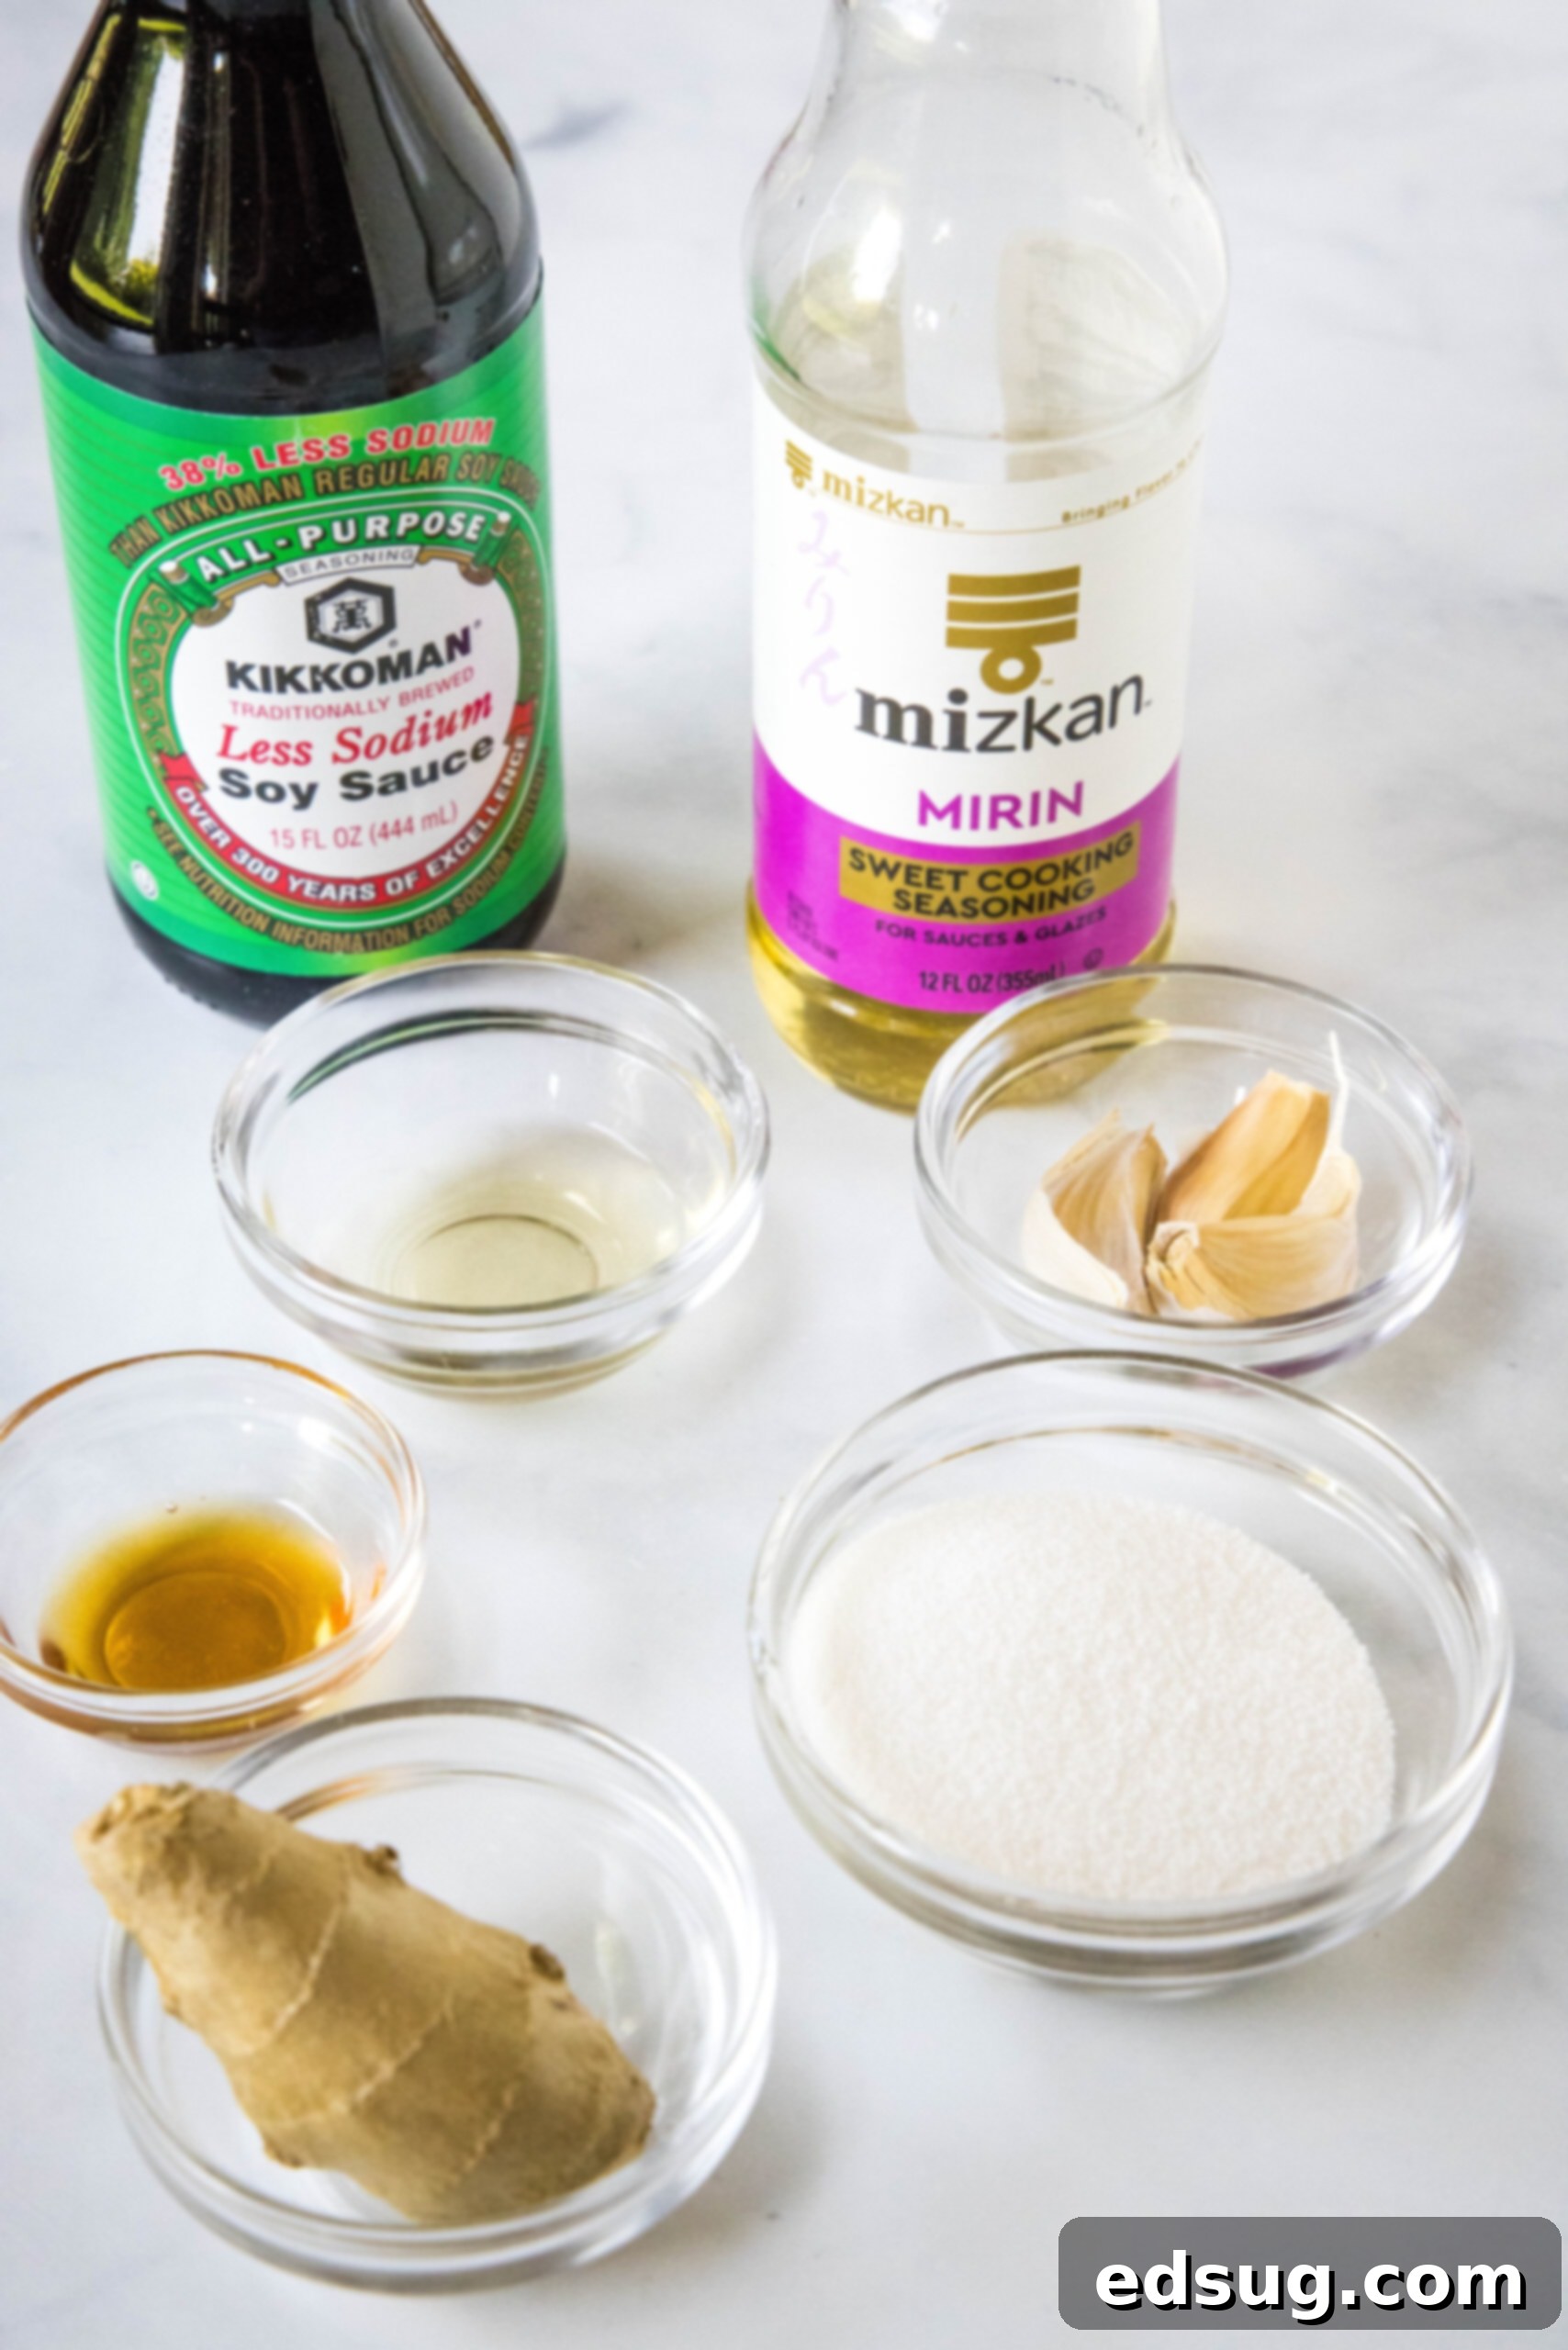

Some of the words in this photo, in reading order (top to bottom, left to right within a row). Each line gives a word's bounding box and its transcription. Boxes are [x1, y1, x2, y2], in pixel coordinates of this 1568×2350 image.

[159, 452, 241, 491] 38%
[252, 431, 351, 472] LESS
[365, 418, 496, 456] SODIUM
[108, 515, 162, 569] THAN
[152, 472, 304, 535] KIKKOMAN
[314, 453, 450, 497] REGULAR
[457, 452, 500, 483] SOY
[822, 469, 950, 528] mizkan
[283, 549, 416, 581] SEASONING
[225, 627, 472, 694] KIKKOMAN
[230, 695, 391, 722] TRADITIONALLY
[398, 666, 476, 707] BREWED
[854, 674, 1145, 755] mizkan
[217, 723, 314, 767] Less
[330, 690, 495, 766] Sodium
[218, 767, 319, 811] Soy
[339, 734, 495, 801] Sauce
[175, 786, 231, 849] OVER
[231, 847, 280, 884] 300
[287, 873, 376, 903] YEARS
[385, 870, 420, 897] OF
[426, 734, 530, 878] EXCELLENCE
[270, 828, 295, 850] 15
[301, 827, 327, 850] FL
[333, 824, 363, 849] OZ
[369, 817, 416, 847] (444
[420, 800, 459, 832] mL)
[918, 781, 1084, 831] MIRIN
[848, 847, 969, 891] SWEET
[977, 830, 1135, 892] COOKING
[178, 853, 270, 934] NUTRITION
[271, 921, 409, 953] INFORMATION
[412, 903, 453, 940] FOR
[875, 919, 916, 942] FOR
[923, 928, 1008, 948] SAUCES
[1014, 930, 1028, 945] &
[1034, 905, 1107, 943] GLAZES
[893, 878, 1095, 921] SEASONING
[919, 970, 938, 991] 12
[942, 973, 962, 993] FL
[967, 972, 994, 994] OZ
